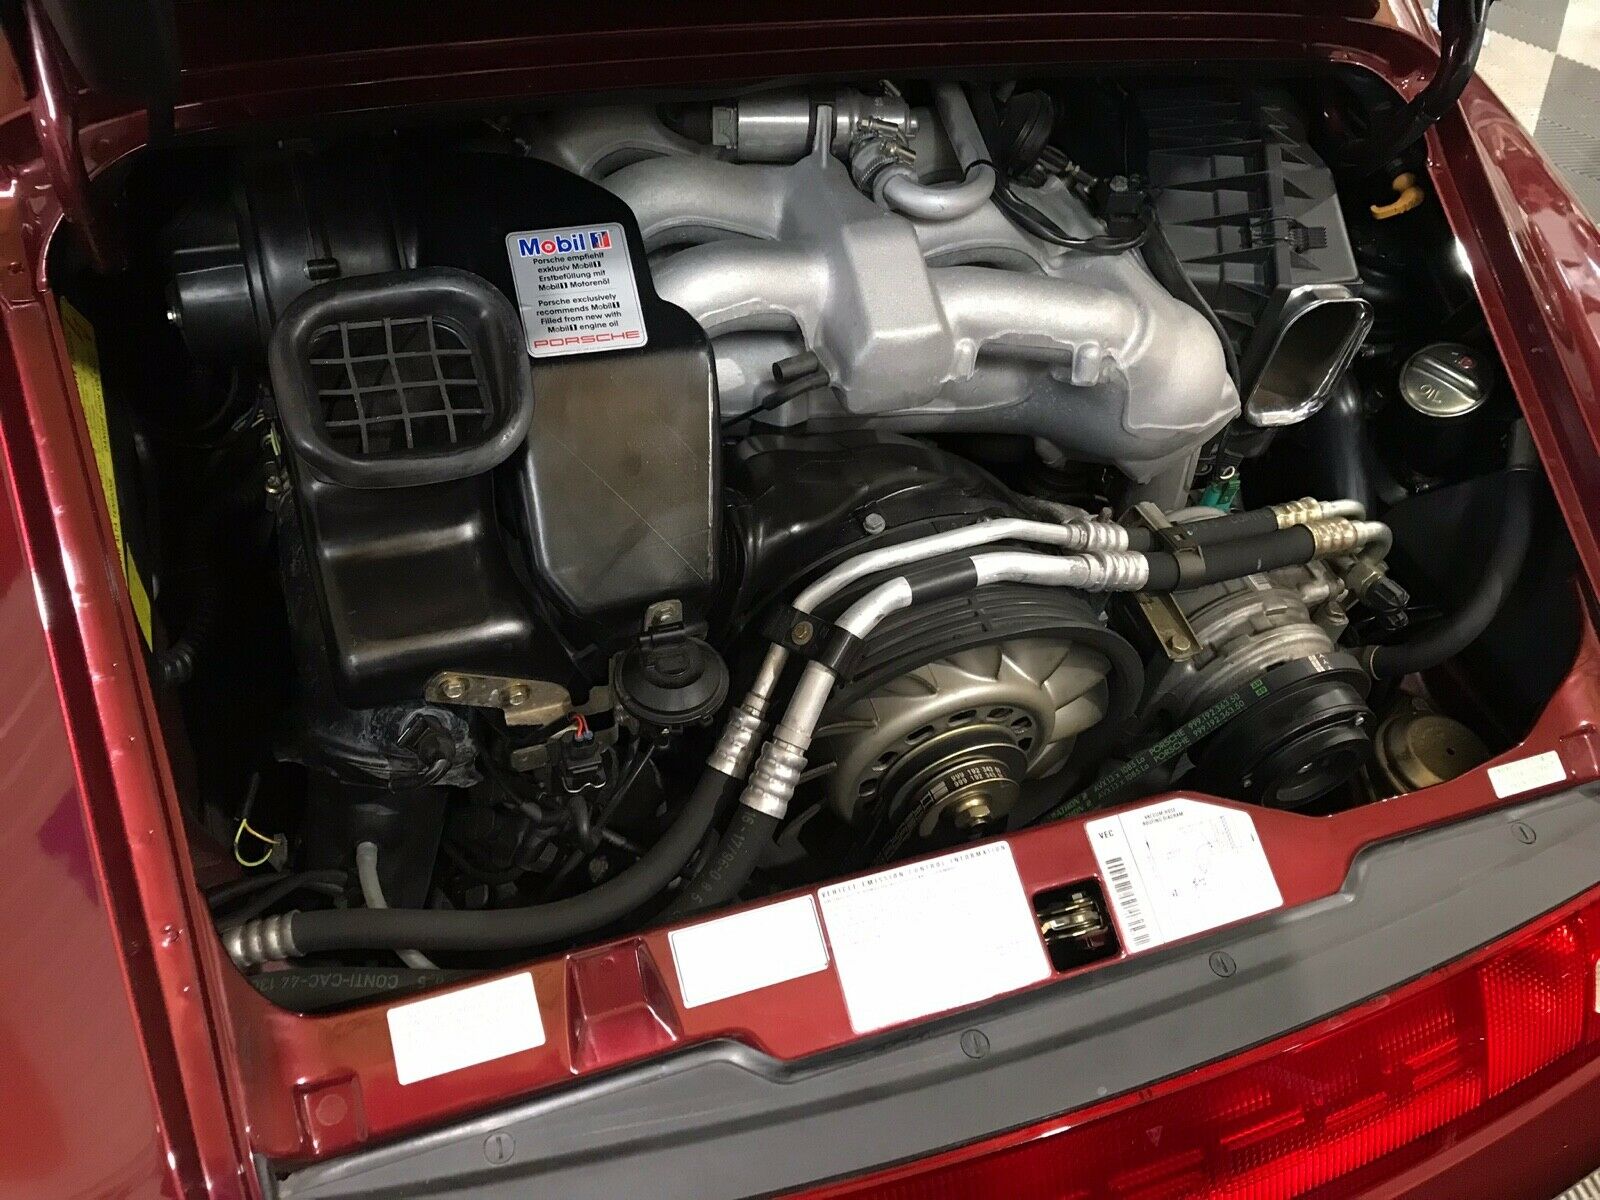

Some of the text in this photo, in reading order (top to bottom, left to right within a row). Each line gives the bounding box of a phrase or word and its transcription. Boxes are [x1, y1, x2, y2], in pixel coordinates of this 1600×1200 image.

[519, 233, 585, 257] Mobil
[533, 252, 604, 265] Porsche empfiehlt
[538, 265, 570, 273] exklusiv
[539, 272, 591, 282] Erstbefüllung
[570, 278, 610, 287] Motorenöl
[538, 294, 617, 307] Porsche exclusively
[536, 306, 589, 316] recommends
[541, 317, 562, 325] Filled
[580, 322, 607, 331] engine
[534, 331, 640, 348] PORSCHE
[1149, 729, 1186, 755] PORSCHE
[1153, 736, 1191, 763] PORSCHE
[1098, 829, 1114, 839] VEC
